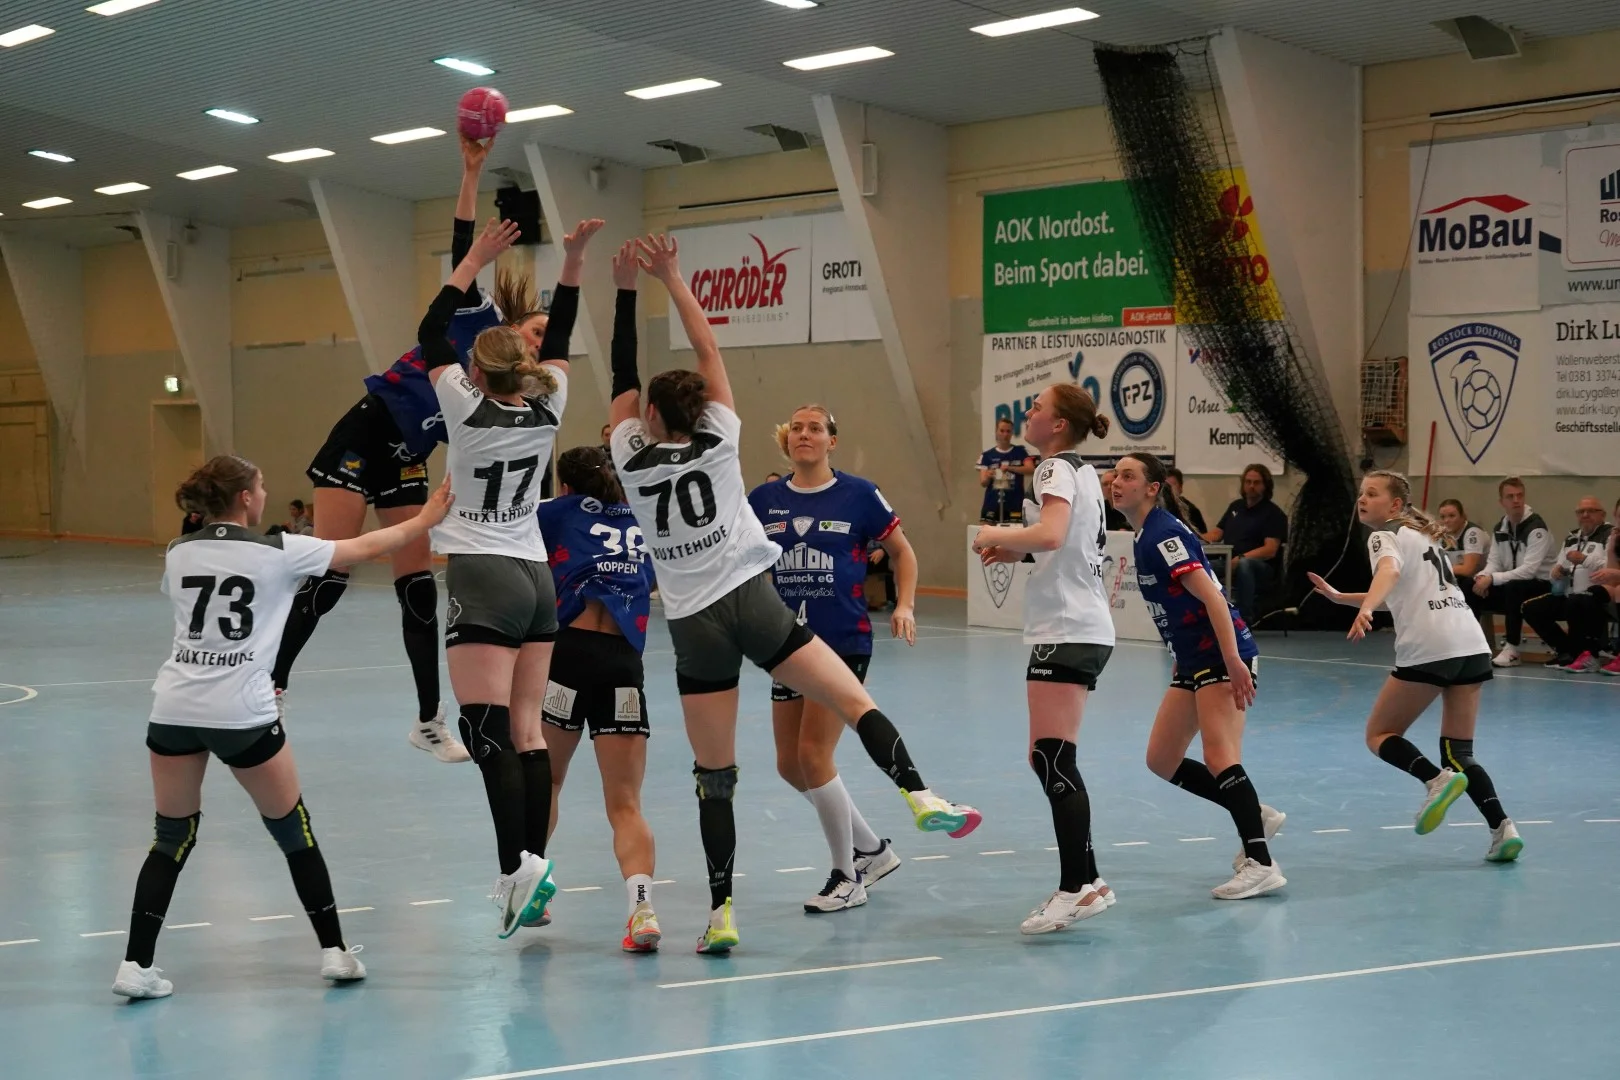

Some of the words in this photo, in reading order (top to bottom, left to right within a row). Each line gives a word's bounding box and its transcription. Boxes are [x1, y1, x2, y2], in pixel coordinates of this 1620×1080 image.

[994, 217, 1034, 244] AOK
[1038, 210, 1115, 240] Nordost.
[1418, 214, 1533, 253] MoBau
[994, 259, 1036, 286] Beim
[1040, 256, 1089, 287] Sport
[1092, 249, 1149, 278] dabei.
[691, 256, 787, 312] SCHRÖDER
[992, 335, 1037, 351] PARTNER
[1041, 329, 1167, 349] LEISTUNGSDIAGNOSTIK
[1431, 326, 1472, 350] ROSTOCK
[1475, 325, 1519, 349] DOLPHINS
[1556, 319, 1599, 341] Dirk
[1121, 380, 1153, 407] FPZ
[1188, 395, 1220, 414] Ostsee
[1209, 427, 1255, 450] Kempa
[474, 455, 539, 512] 17
[638, 470, 717, 537] 70
[768, 508, 790, 516] Kempa
[596, 561, 638, 574] KOPPEN
[777, 574, 814, 585] Rostock
[817, 573, 834, 583] eG
[181, 575, 255, 641] 73
[1030, 667, 1053, 676] Kempa
